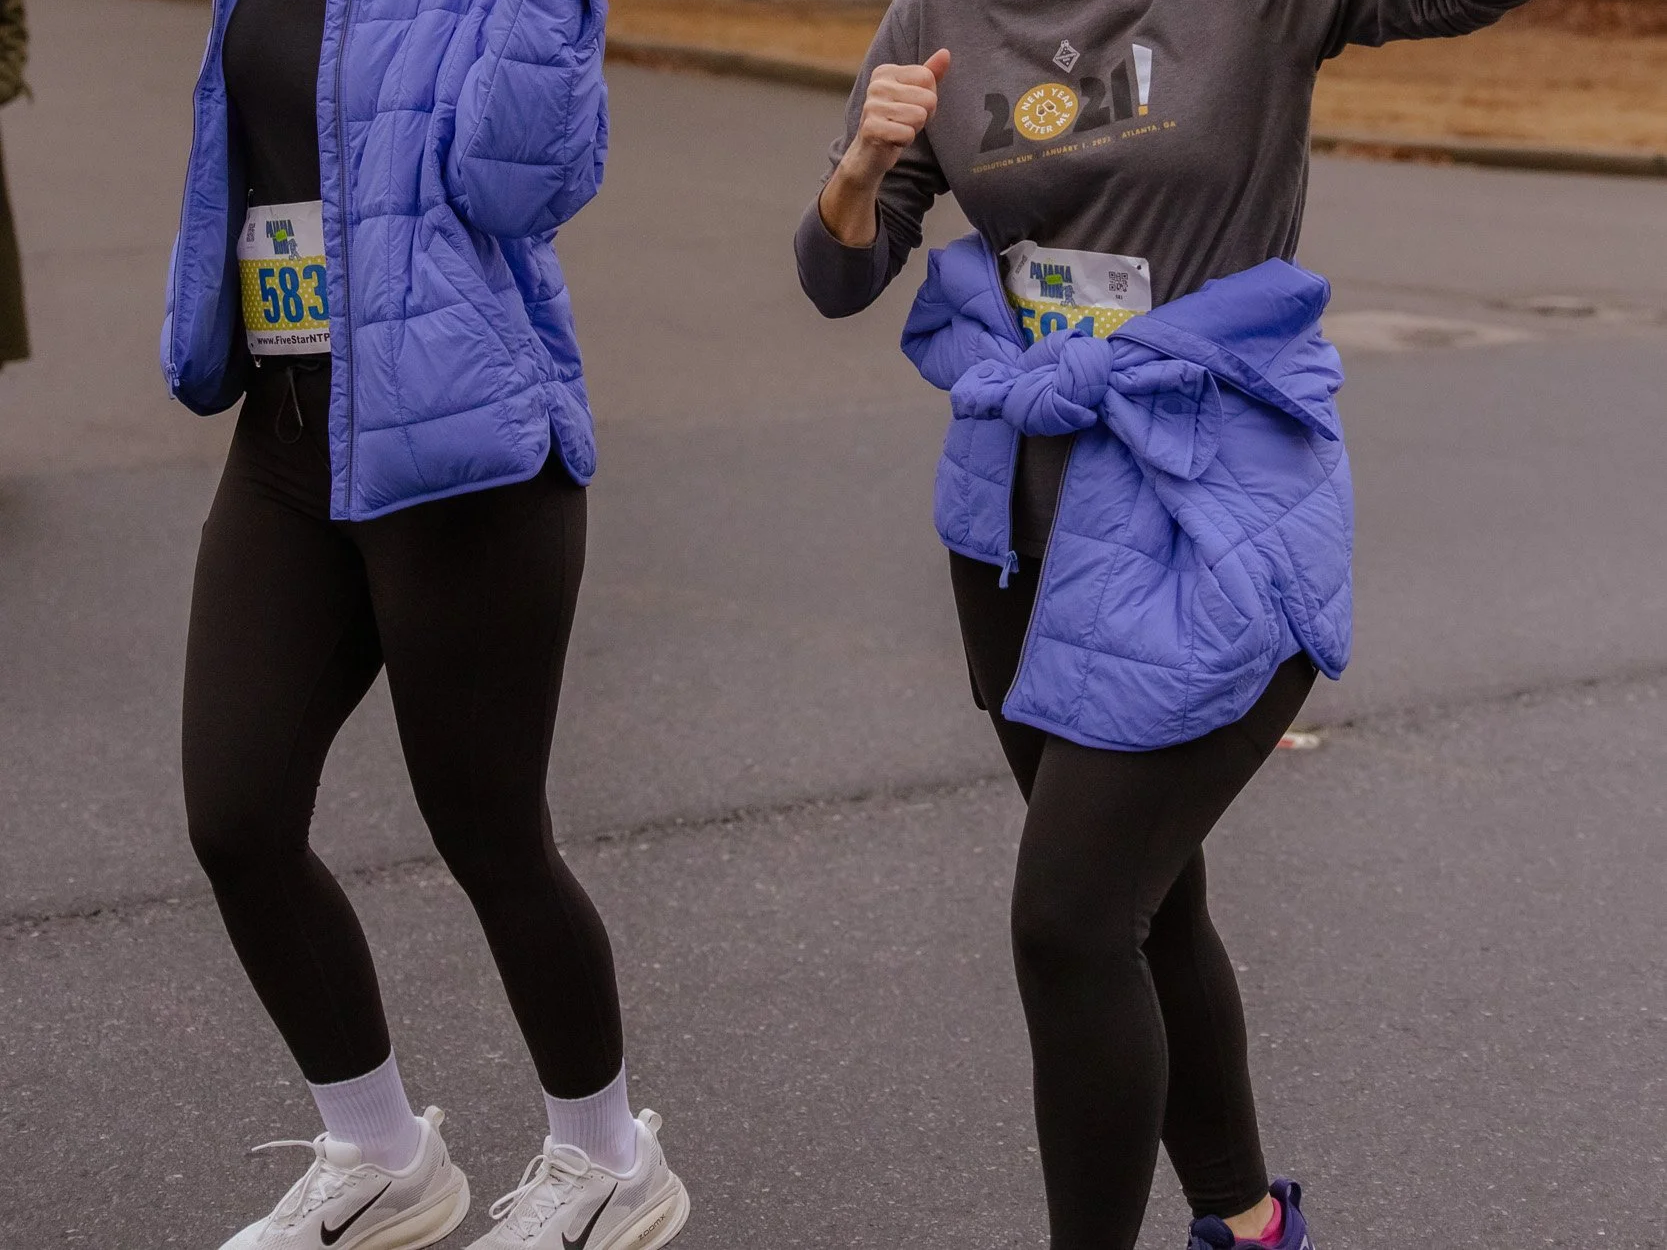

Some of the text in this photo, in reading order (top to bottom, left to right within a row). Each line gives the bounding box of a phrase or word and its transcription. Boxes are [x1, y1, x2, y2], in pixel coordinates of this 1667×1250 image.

[1021, 87, 1073, 111] NEW YEAR
[1021, 113, 1070, 135] BETTER ME
[258, 264, 330, 324] 583
